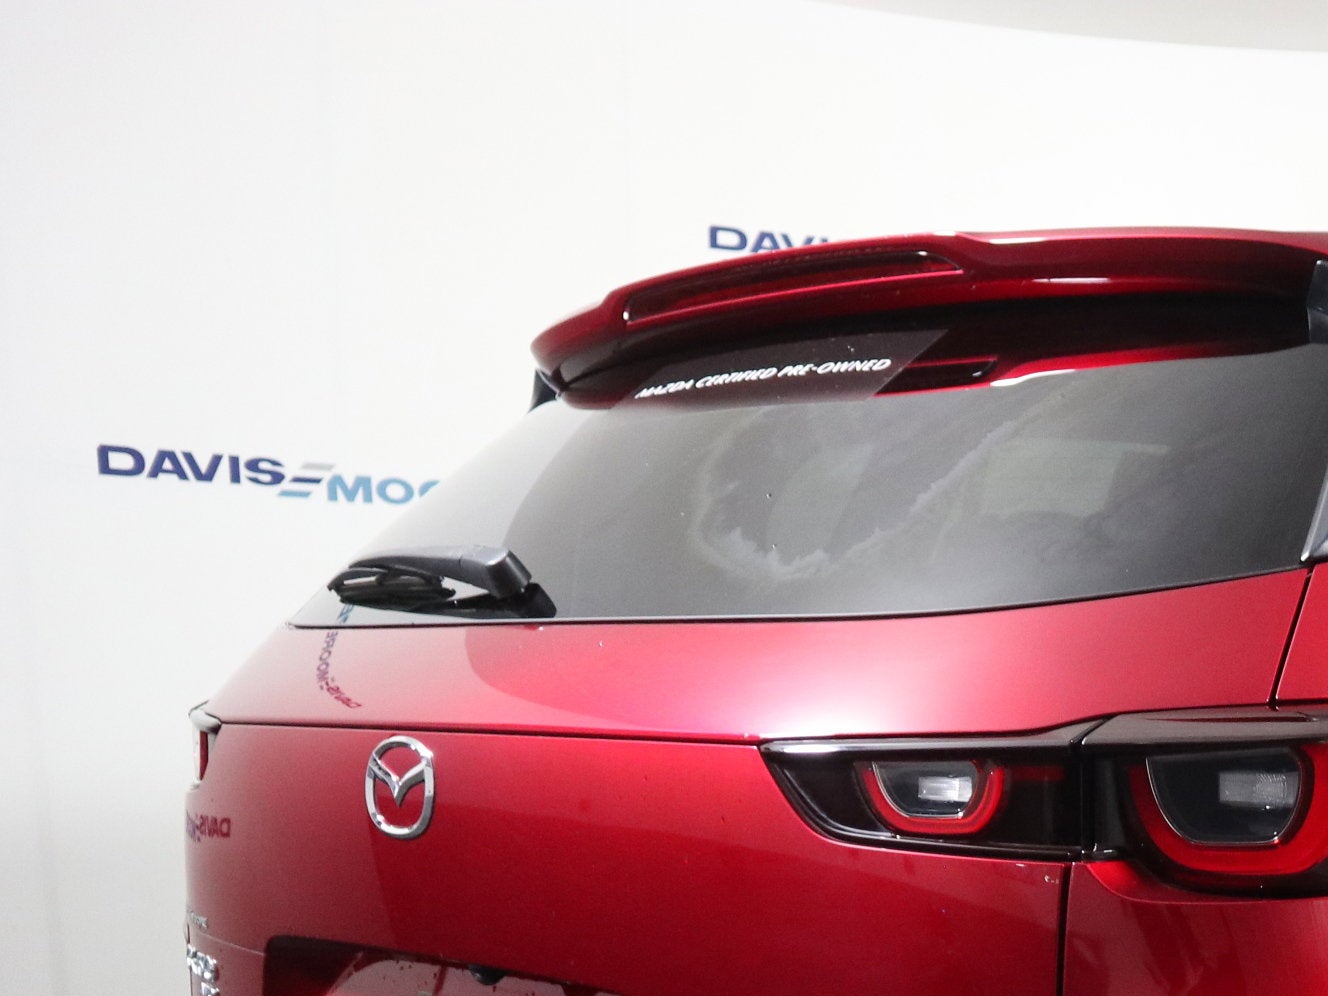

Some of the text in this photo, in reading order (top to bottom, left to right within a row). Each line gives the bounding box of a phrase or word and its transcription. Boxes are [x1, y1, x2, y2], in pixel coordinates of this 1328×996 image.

[634, 358, 892, 400] MAZDA CERTIFIED PRE-OWNED
[97, 444, 286, 487] DAVIS
